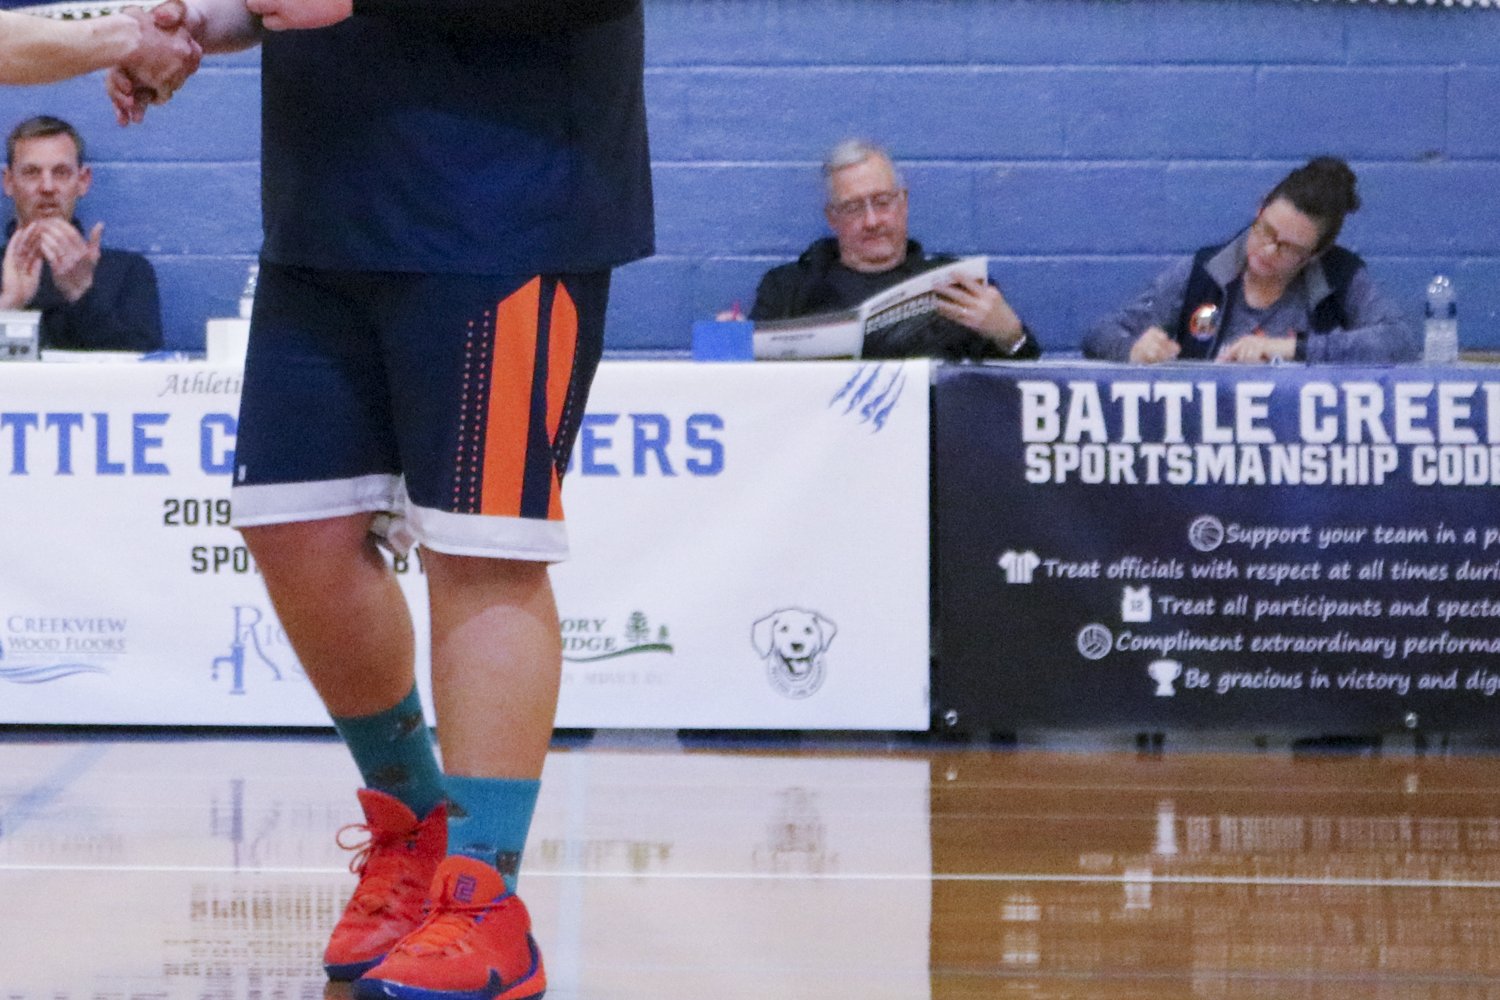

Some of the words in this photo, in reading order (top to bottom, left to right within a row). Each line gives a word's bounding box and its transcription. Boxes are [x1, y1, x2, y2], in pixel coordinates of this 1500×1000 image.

[158, 370, 243, 397] Athleti
[1017, 381, 1277, 444] BATTLE
[1025, 443, 1399, 486] SPORTSMANSHIP
[1226, 523, 1312, 549] Support
[1318, 526, 1368, 549] your
[1373, 524, 1429, 544] team
[1435, 521, 1457, 544] in
[1463, 527, 1478, 544] a
[1043, 558, 1101, 579] Treat
[1106, 555, 1185, 580] officials
[1191, 557, 1240, 579] with
[1246, 560, 1322, 586] respect
[1328, 560, 1352, 580] at
[1358, 557, 1385, 580] all
[1390, 558, 1449, 581] times
[1455, 558, 1500, 581] duri
[1157, 594, 1216, 616] Treat
[1222, 594, 1250, 616] all
[1254, 594, 1383, 623] participants
[1388, 594, 1430, 618] and
[1436, 598, 1500, 624] specta
[561, 619, 607, 633] ORY
[1115, 630, 1245, 657] Compliment
[1251, 630, 1398, 659] extraordinary
[1402, 629, 1500, 659] performa
[1184, 668, 1211, 689] Be
[1216, 667, 1304, 695] gracious
[1310, 667, 1332, 690] in
[1337, 667, 1412, 697] victory
[1417, 668, 1460, 690] and
[1465, 668, 1500, 697] dig
